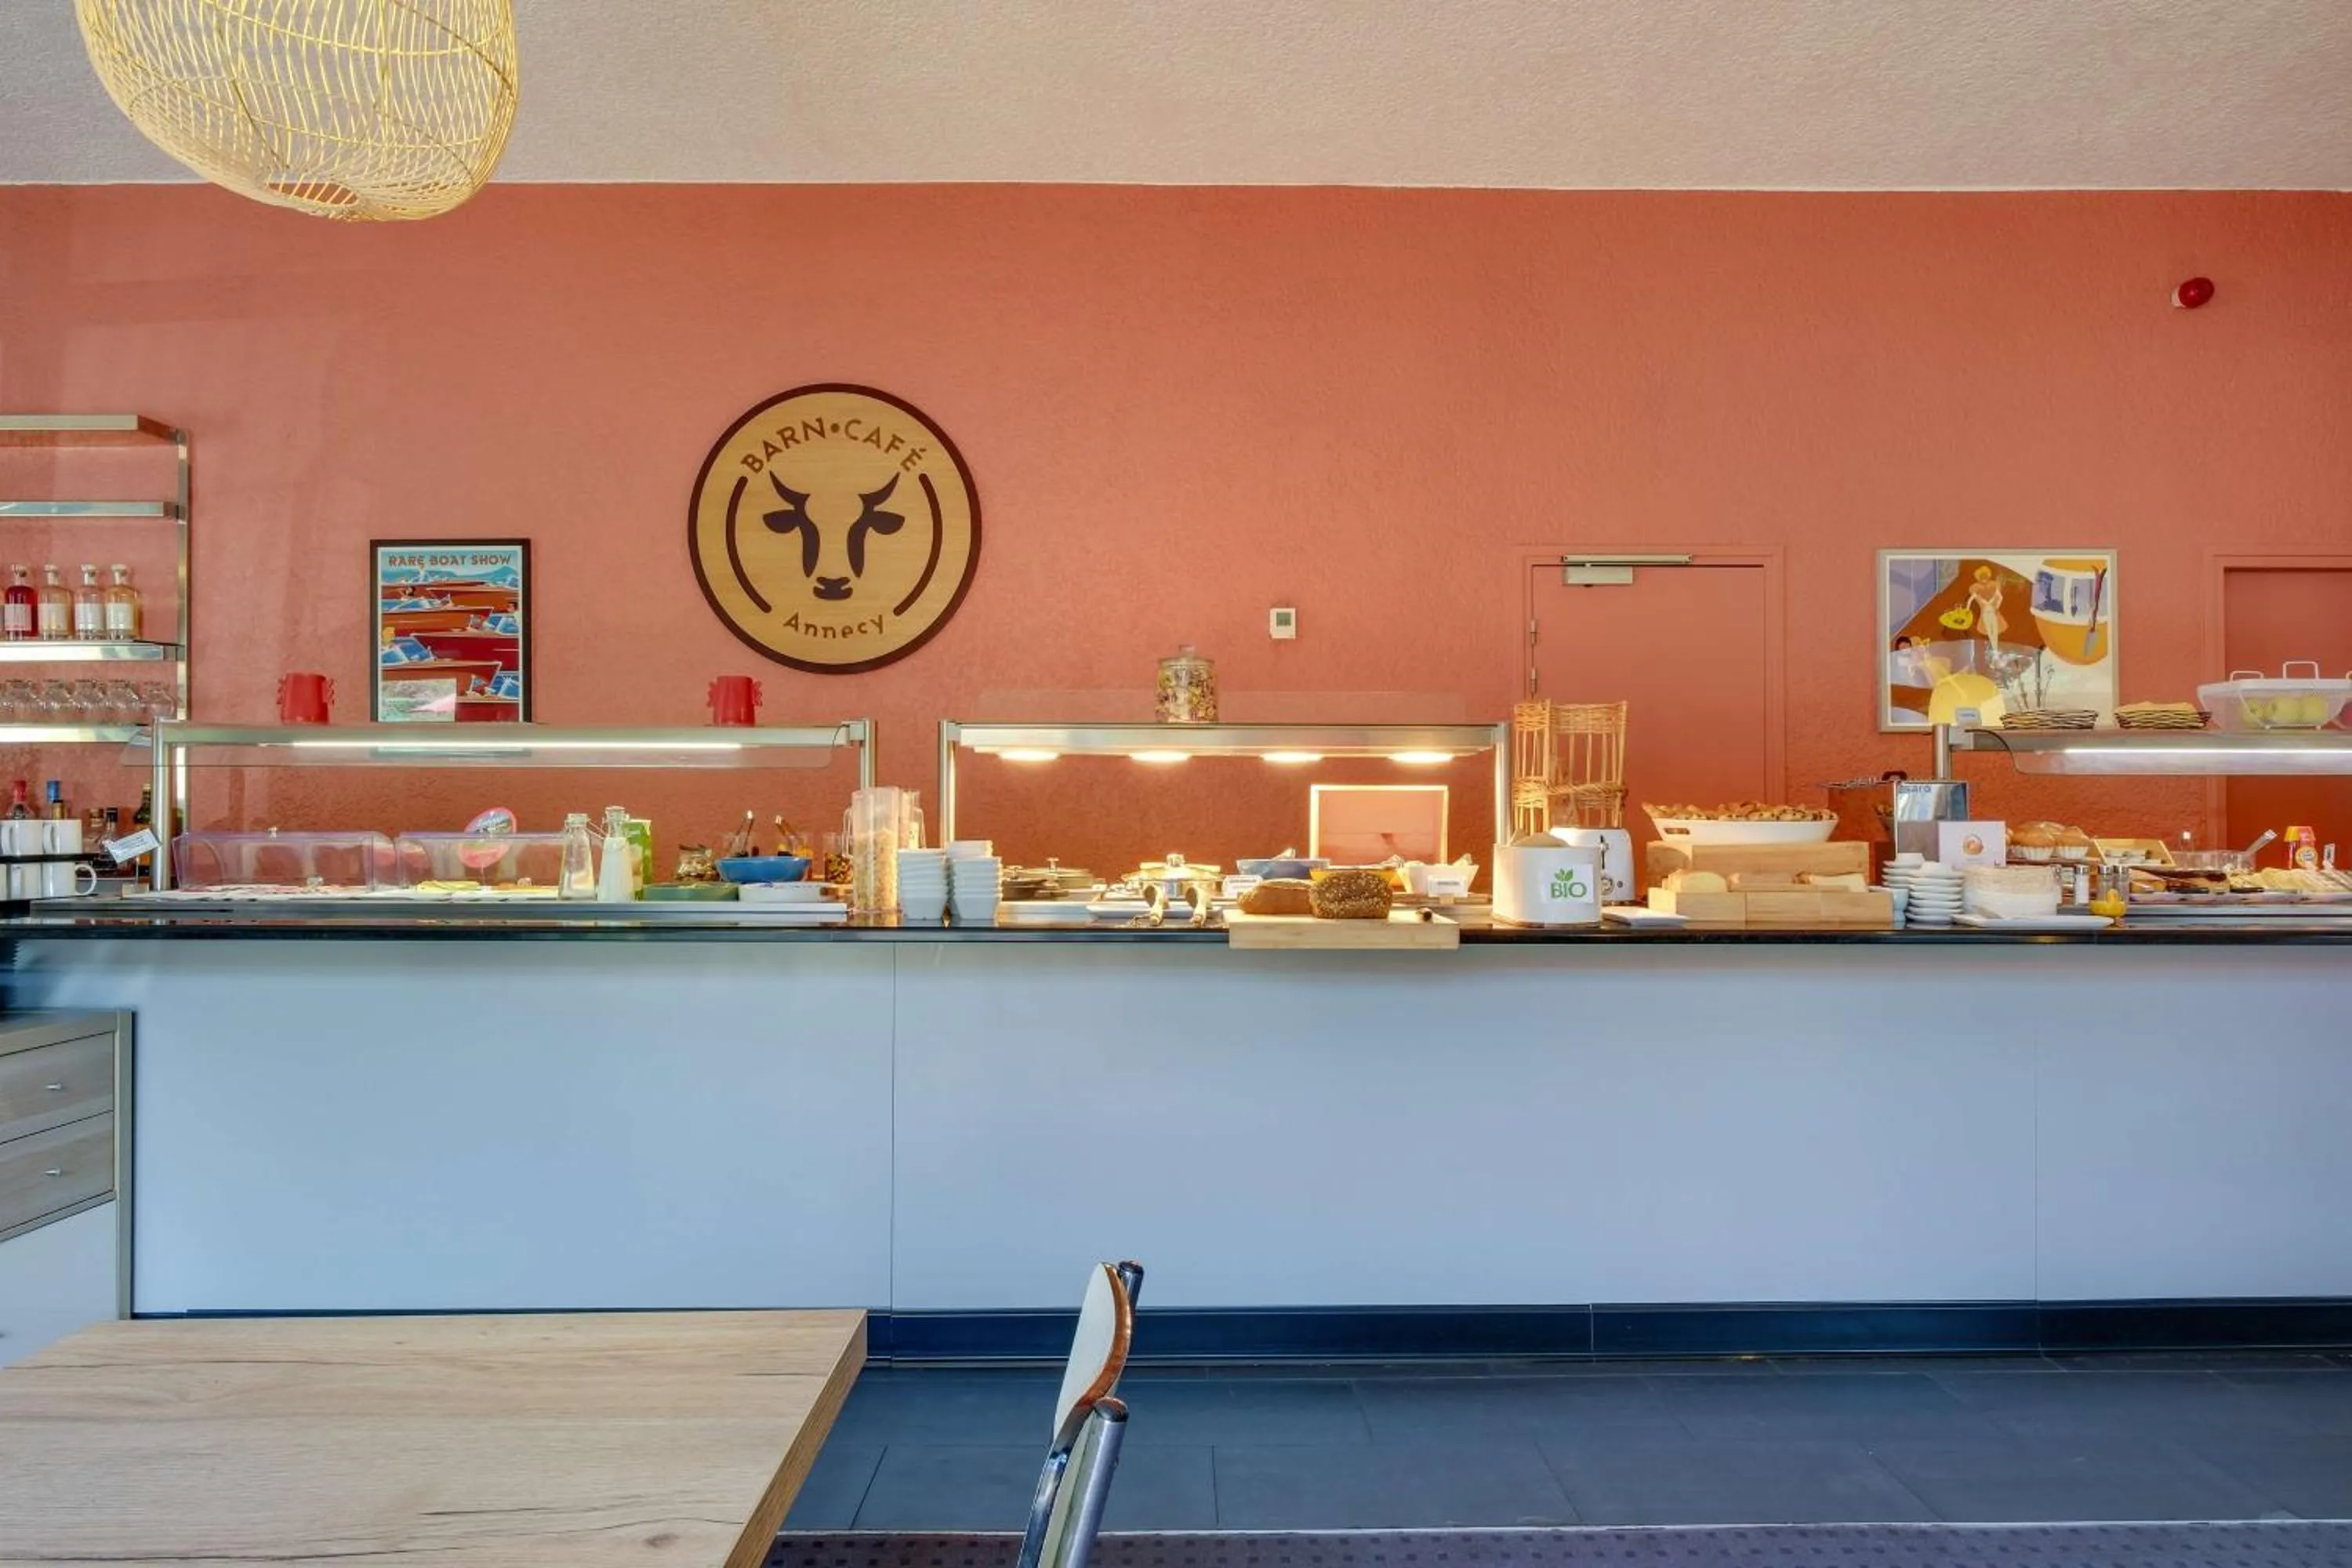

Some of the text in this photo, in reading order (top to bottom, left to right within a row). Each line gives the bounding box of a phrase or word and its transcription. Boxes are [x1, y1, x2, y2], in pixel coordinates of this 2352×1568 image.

[388, 554, 511, 566] RARE BOAT SHOW
[782, 612, 884, 639] Annecy
[1551, 881, 1587, 898] BIO
